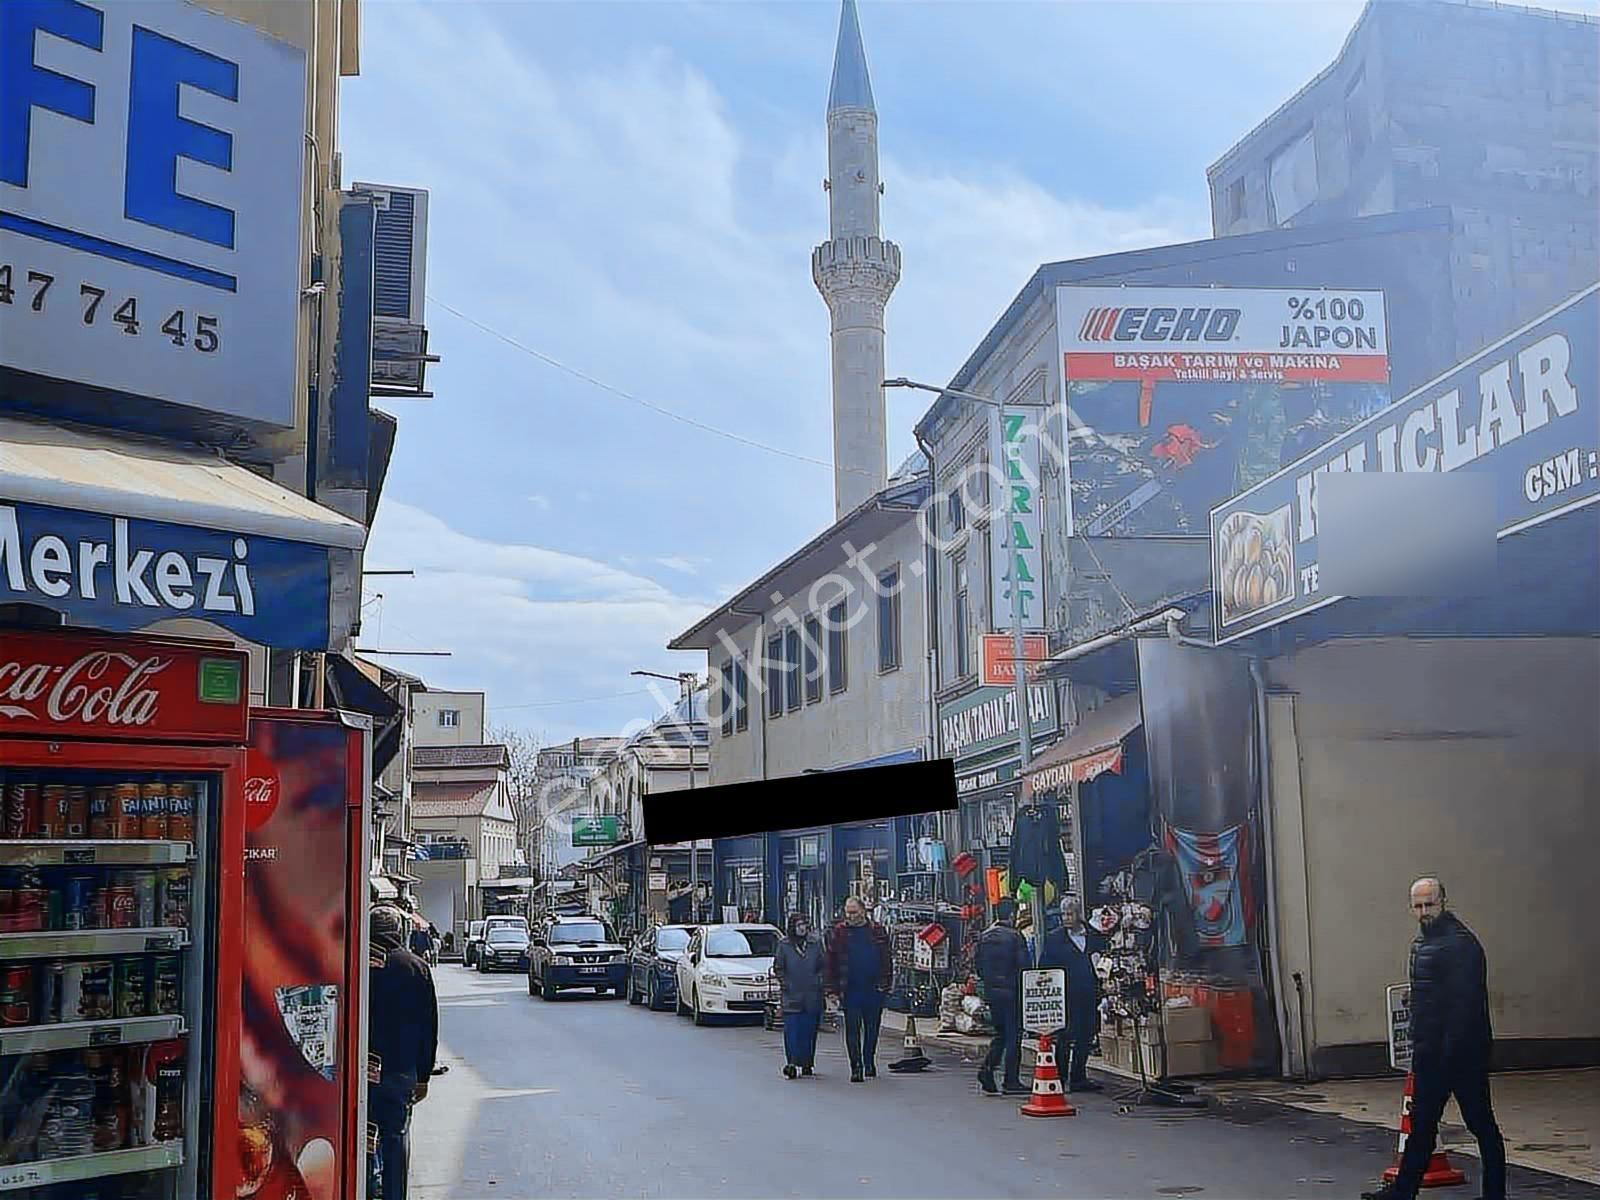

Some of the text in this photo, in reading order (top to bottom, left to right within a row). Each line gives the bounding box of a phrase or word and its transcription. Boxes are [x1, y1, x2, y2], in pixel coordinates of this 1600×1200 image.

[79, 283, 140, 335] 74
[161, 310, 220, 354] 45
[1112, 296, 1365, 342] ECHO %100
[1279, 325, 1377, 349] JAPON
[1182, 355, 1239, 368] TARIM
[1244, 357, 1263, 368] ve
[1525, 448, 1583, 503] GSM
